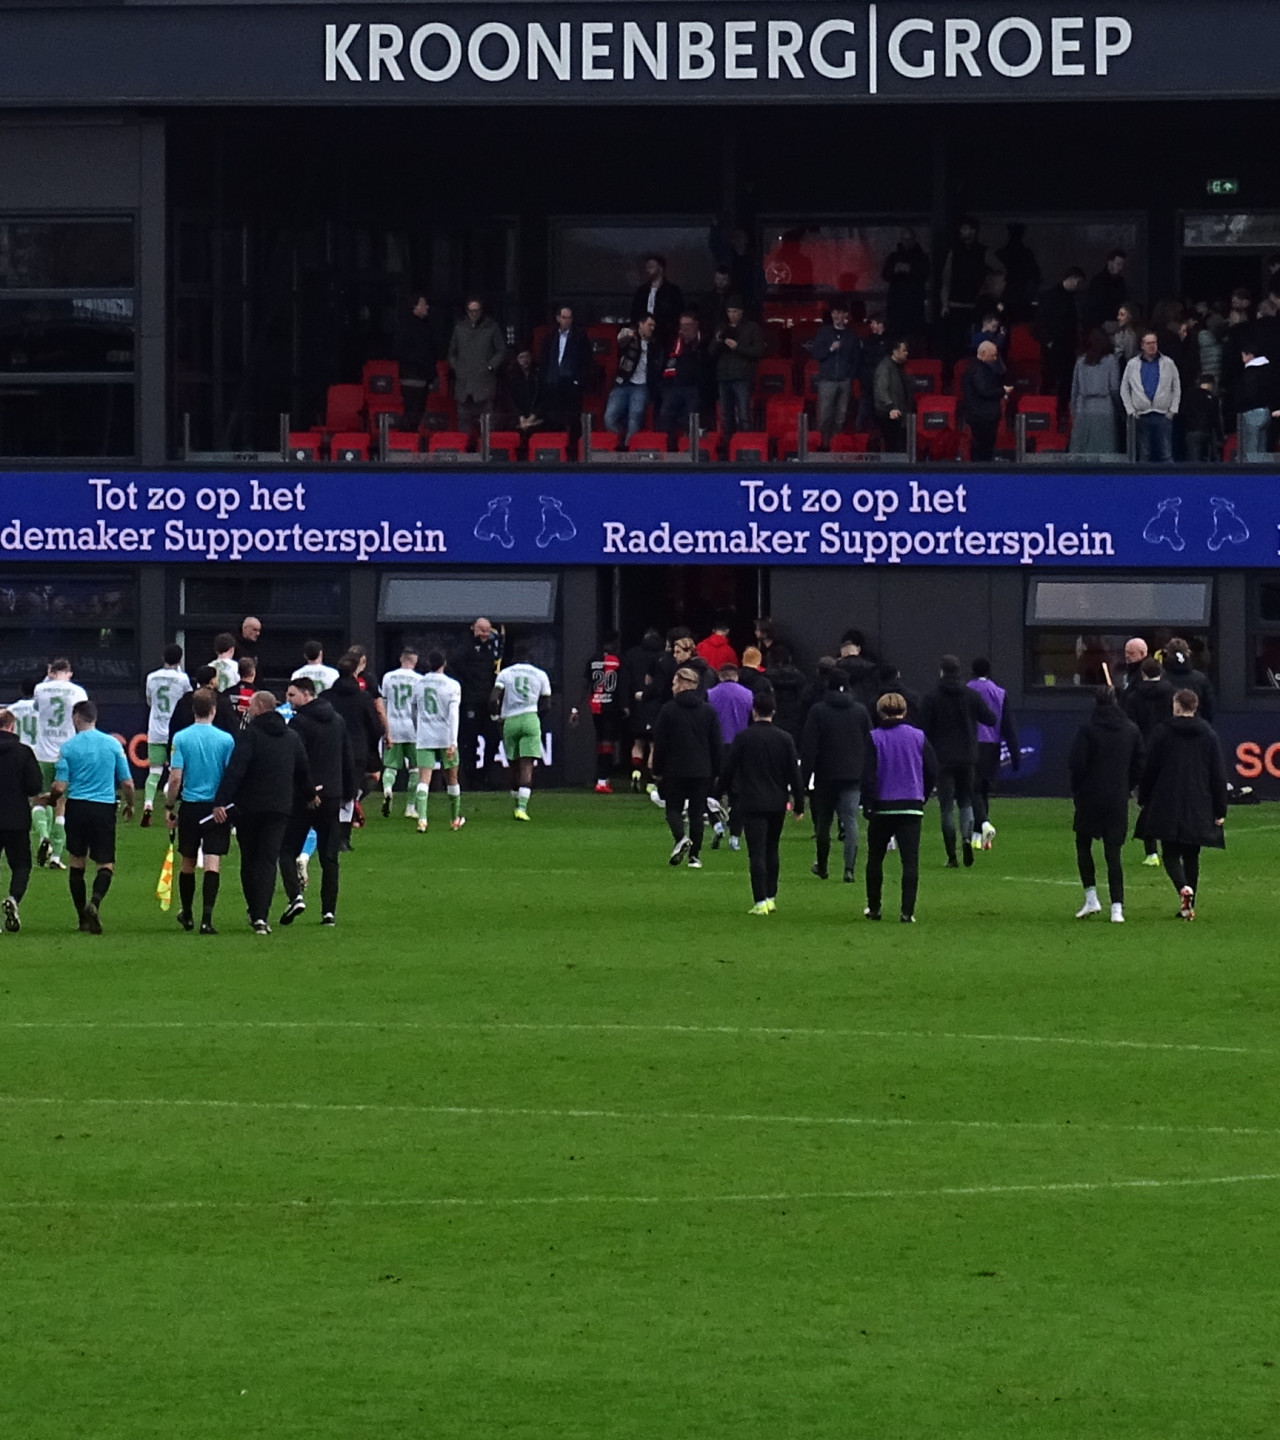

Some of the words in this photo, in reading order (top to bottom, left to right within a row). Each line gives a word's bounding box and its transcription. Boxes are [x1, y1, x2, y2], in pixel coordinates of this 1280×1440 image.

[324, 17, 857, 82] KROONENBERG
[887, 16, 1133, 79] GROEP
[89, 479, 138, 511] Tot
[148, 487, 186, 511] zo
[196, 487, 241, 520] op
[250, 479, 306, 511] het
[740, 481, 792, 513] Tot
[802, 489, 842, 513] zo
[853, 489, 899, 521] op
[909, 480, 967, 513] het
[164, 517, 447, 561] Supportersplein
[603, 521, 811, 555] Rademaker
[820, 519, 1115, 564] Supportersplein
[48, 696, 65, 728] 3
